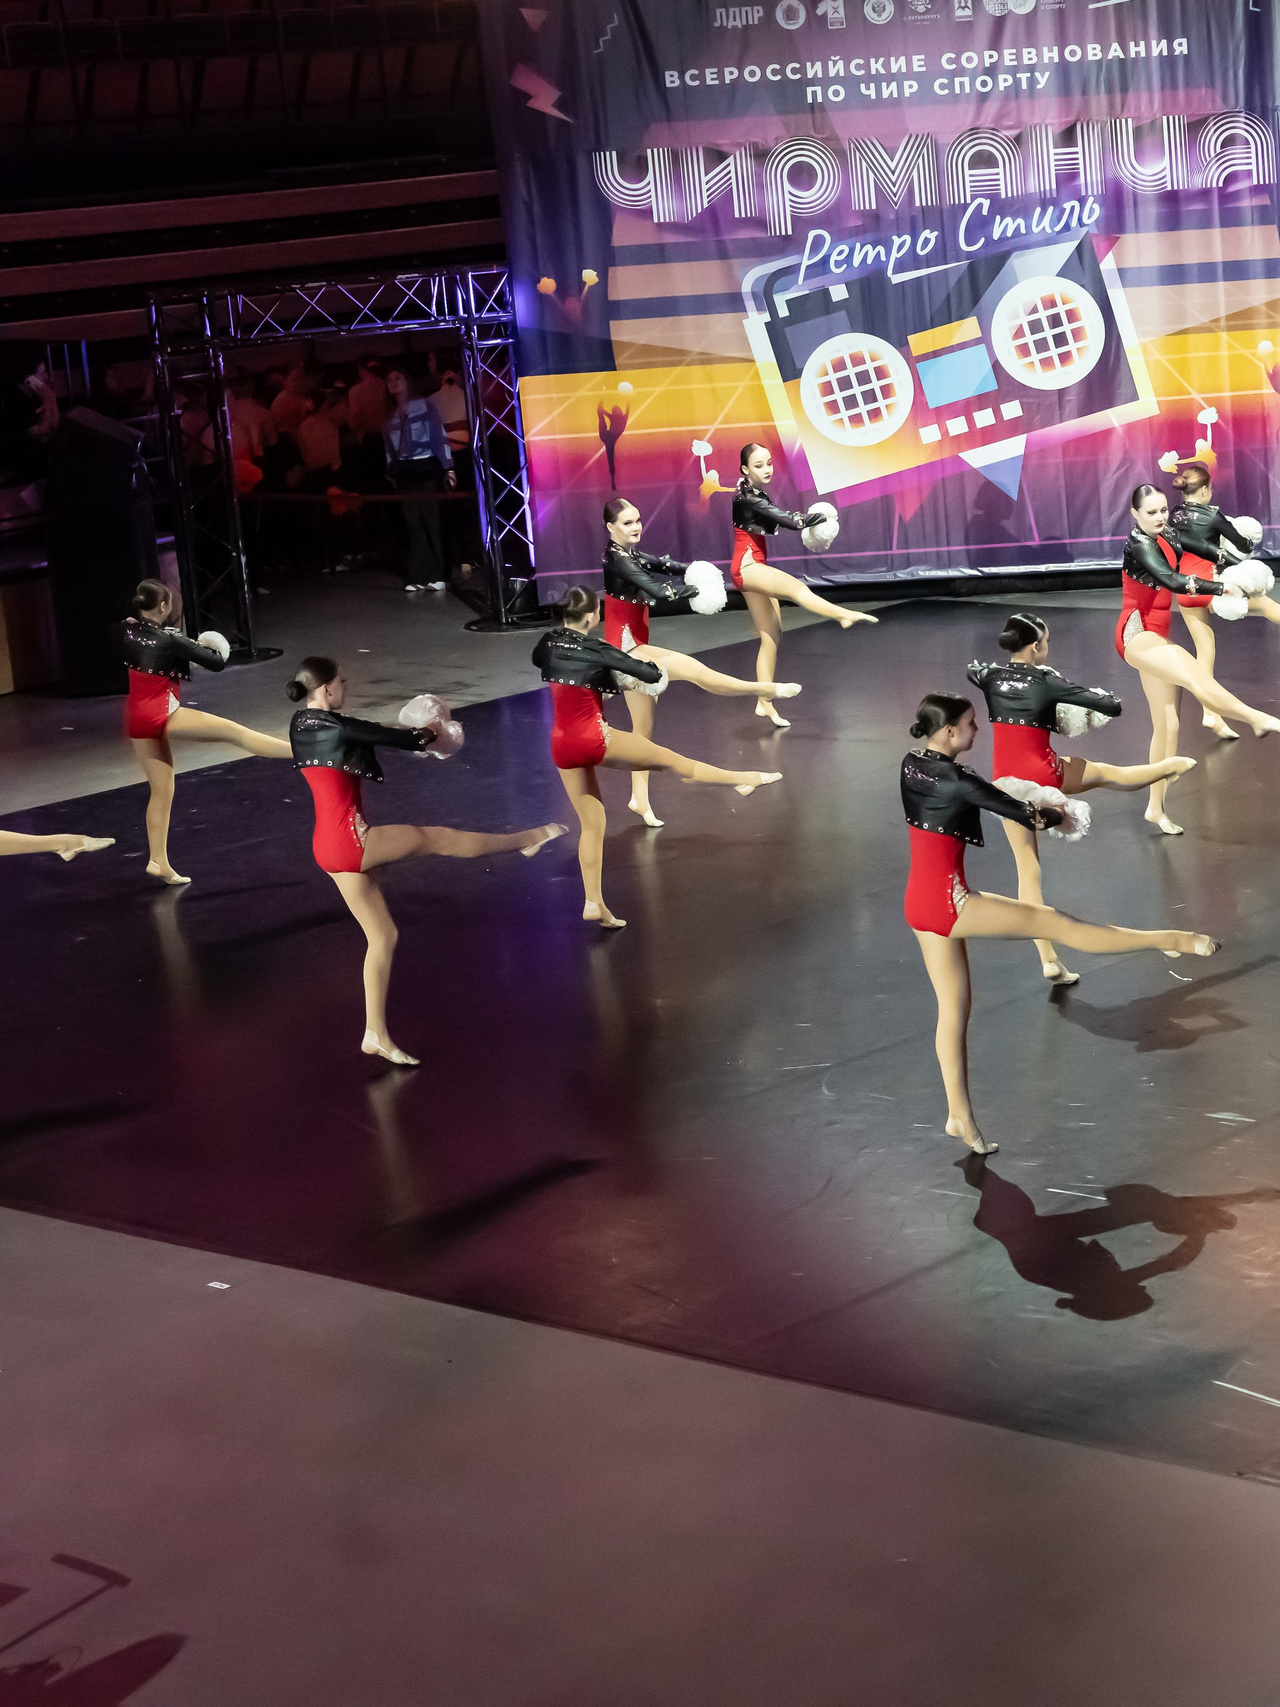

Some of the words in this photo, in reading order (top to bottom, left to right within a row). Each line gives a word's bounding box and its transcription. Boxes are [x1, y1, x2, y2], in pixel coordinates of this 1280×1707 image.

[714, 6, 764, 29] ЛДПР
[665, 54, 926, 88] ВСЕРОССИЙСКИЕ
[941, 37, 1188, 70] СОРЕВНОВАНИЯ
[806, 84, 846, 103] ПО
[860, 80, 919, 99] ЧИР
[933, 71, 1050, 95] СПОРТУ
[798, 229, 939, 286] Ретро
[958, 196, 1100, 252] Стиль
